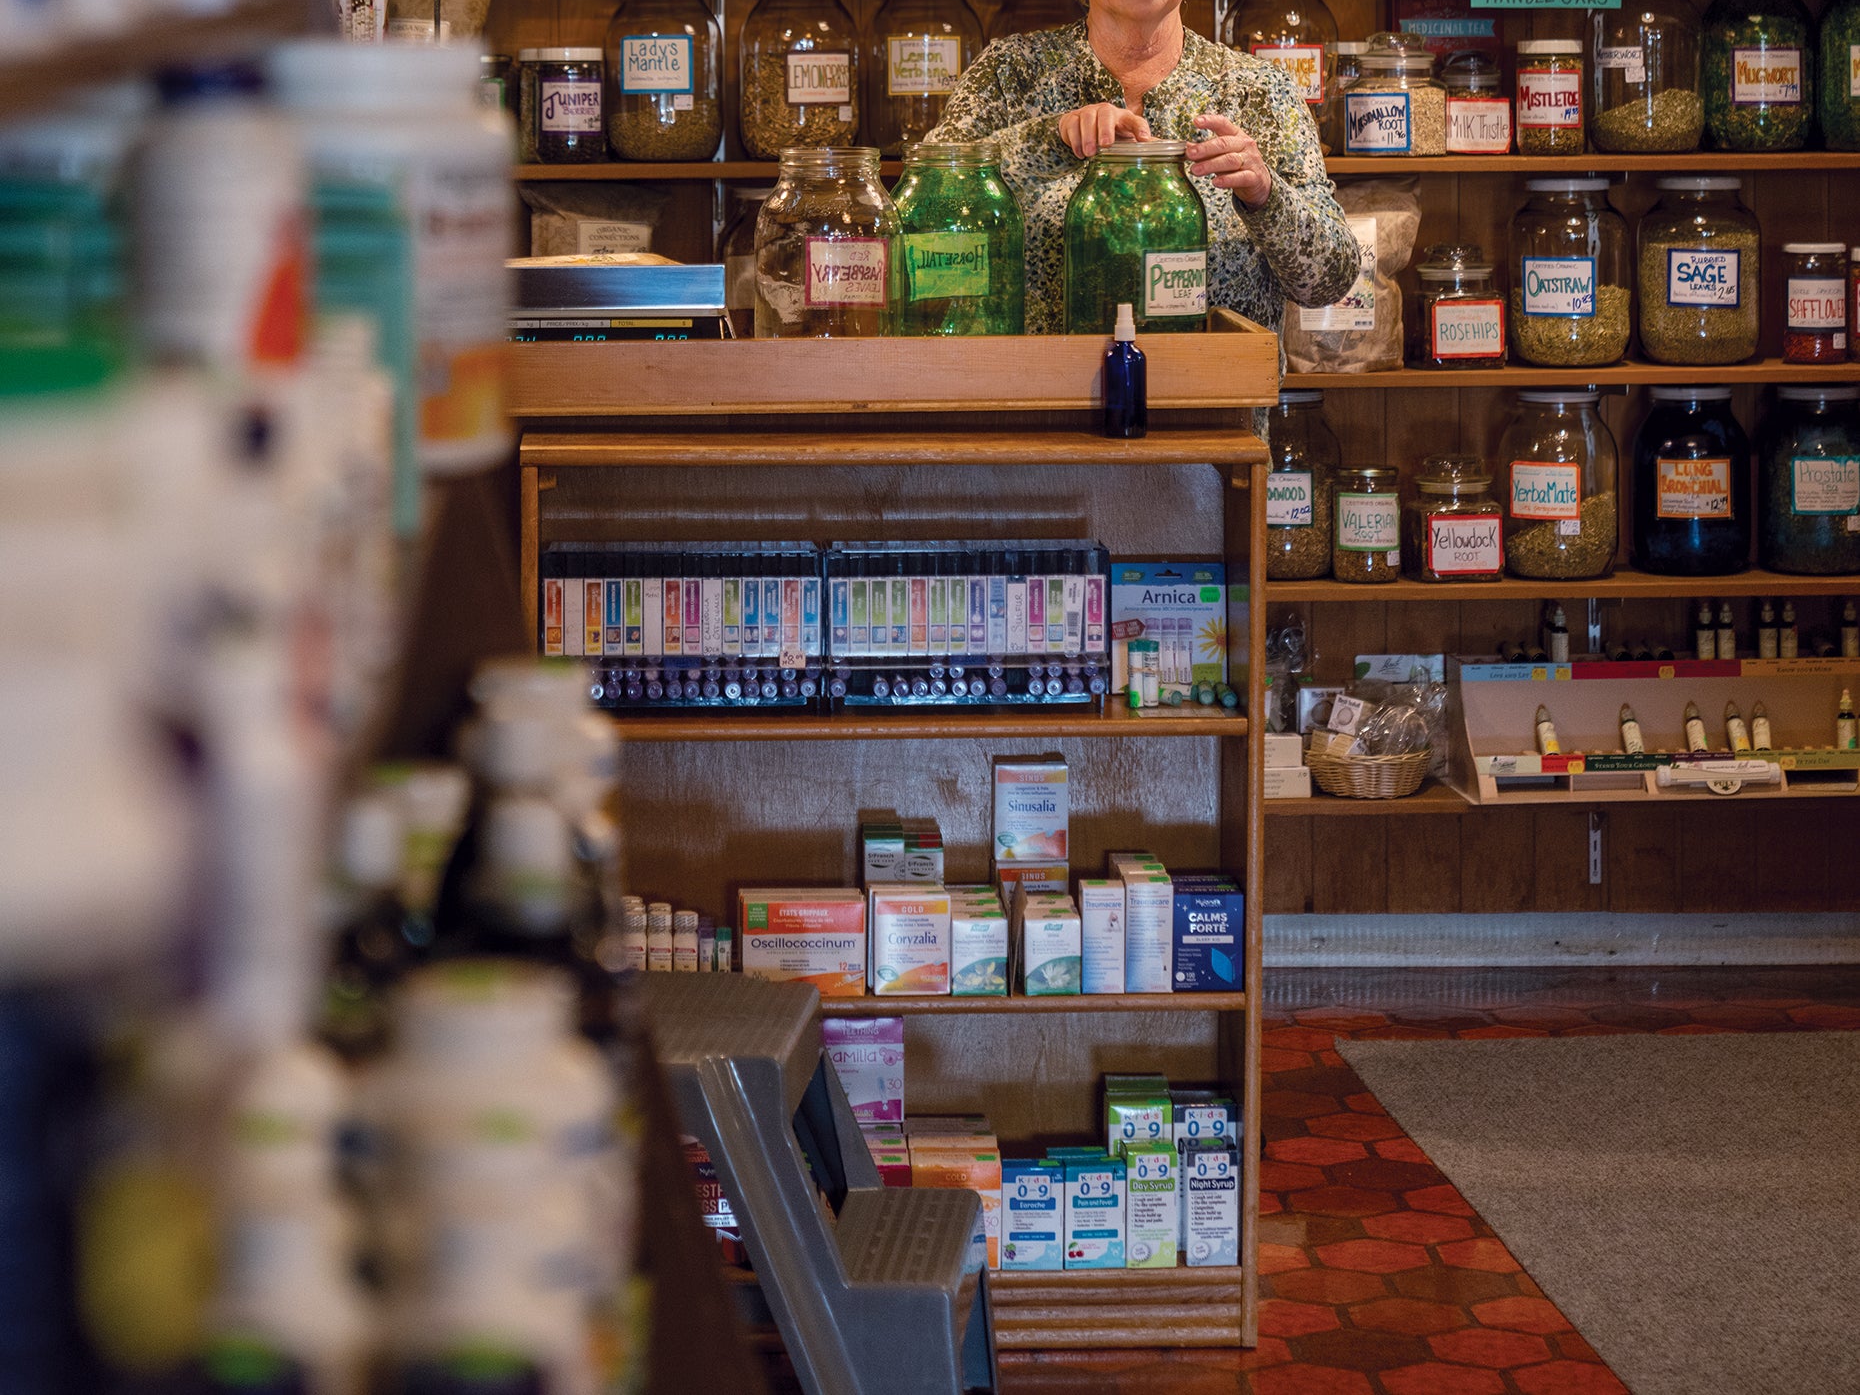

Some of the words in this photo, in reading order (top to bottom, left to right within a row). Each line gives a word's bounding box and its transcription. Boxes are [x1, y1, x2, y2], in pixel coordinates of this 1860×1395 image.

[1408, 23, 1465, 35] MEDICINAL
[1467, 23, 1486, 34] TEA
[629, 41, 679, 57] Lady's
[628, 56, 681, 73] Mantle
[1520, 85, 1579, 107] MISTLETOE
[543, 91, 600, 120] JUNIPER
[1378, 119, 1404, 131] ROOT
[1677, 262, 1728, 284] SAGE
[1526, 269, 1593, 298] OATSTRAW
[1689, 282, 1717, 292] LEAVES
[1439, 321, 1499, 342] ROSEHIPS
[1674, 462, 1714, 477] LUNG
[1799, 460, 1857, 484] Prostate
[1454, 551, 1481, 562] ROOT
[1141, 589, 1197, 604] Arnica
[1019, 773, 1046, 782] SINUS
[1007, 799, 1057, 814] Sinusalia
[1188, 912, 1228, 923] CALMS
[750, 937, 856, 949] Oscillococcinum
[888, 931, 938, 947] Coryzalia
[886, 1078, 903, 1090] 30
[1132, 1181, 1148, 1190] Day
[1150, 1181, 1174, 1192] Syrup
[1190, 1179, 1211, 1190] Night
[1212, 1179, 1235, 1190] Syrup
